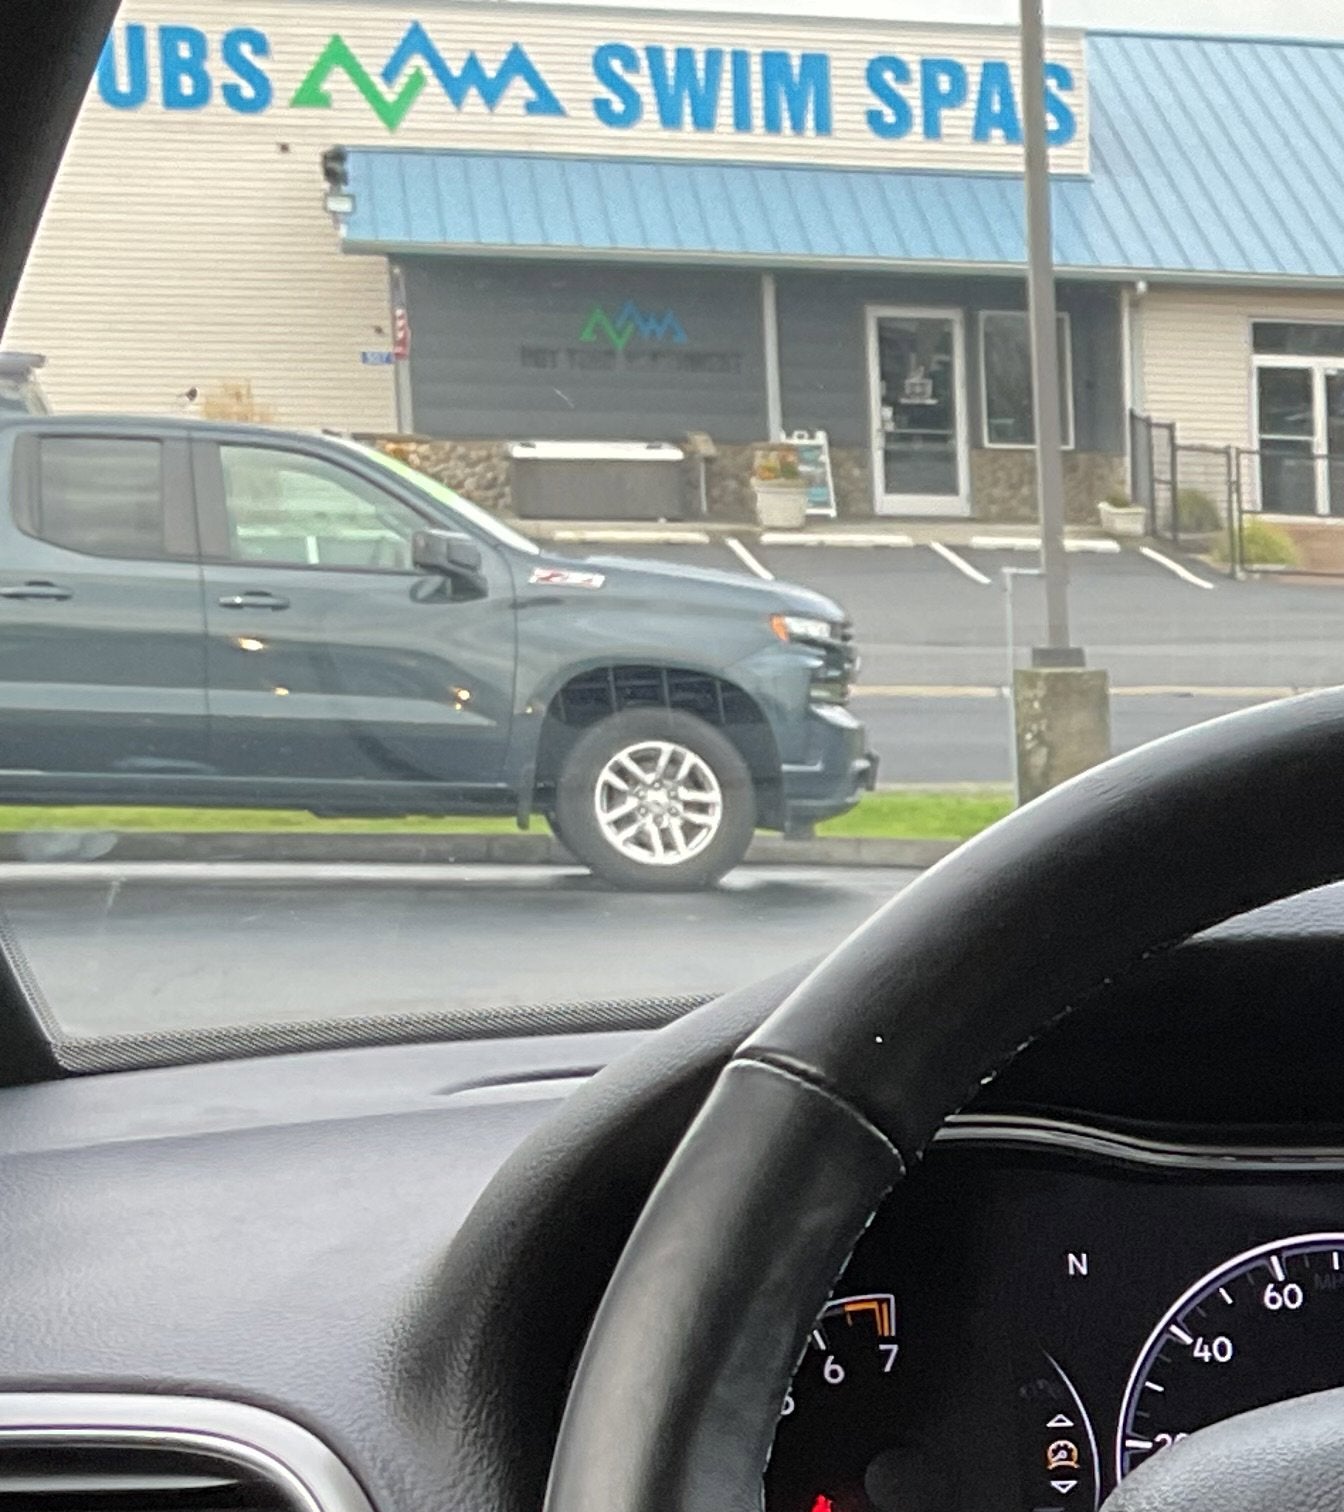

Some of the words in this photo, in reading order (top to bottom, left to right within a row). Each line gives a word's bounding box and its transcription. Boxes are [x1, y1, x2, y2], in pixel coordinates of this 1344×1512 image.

[97, 23, 273, 114] UBS
[592, 43, 833, 133] SWIM
[865, 54, 1077, 146] SPAS
[1068, 1253, 1088, 1275] N
[1263, 1283, 1303, 1310] 60
[879, 1344, 899, 1372] 7
[1193, 1335, 1233, 1362] 40
[824, 1355, 845, 1384] 6
